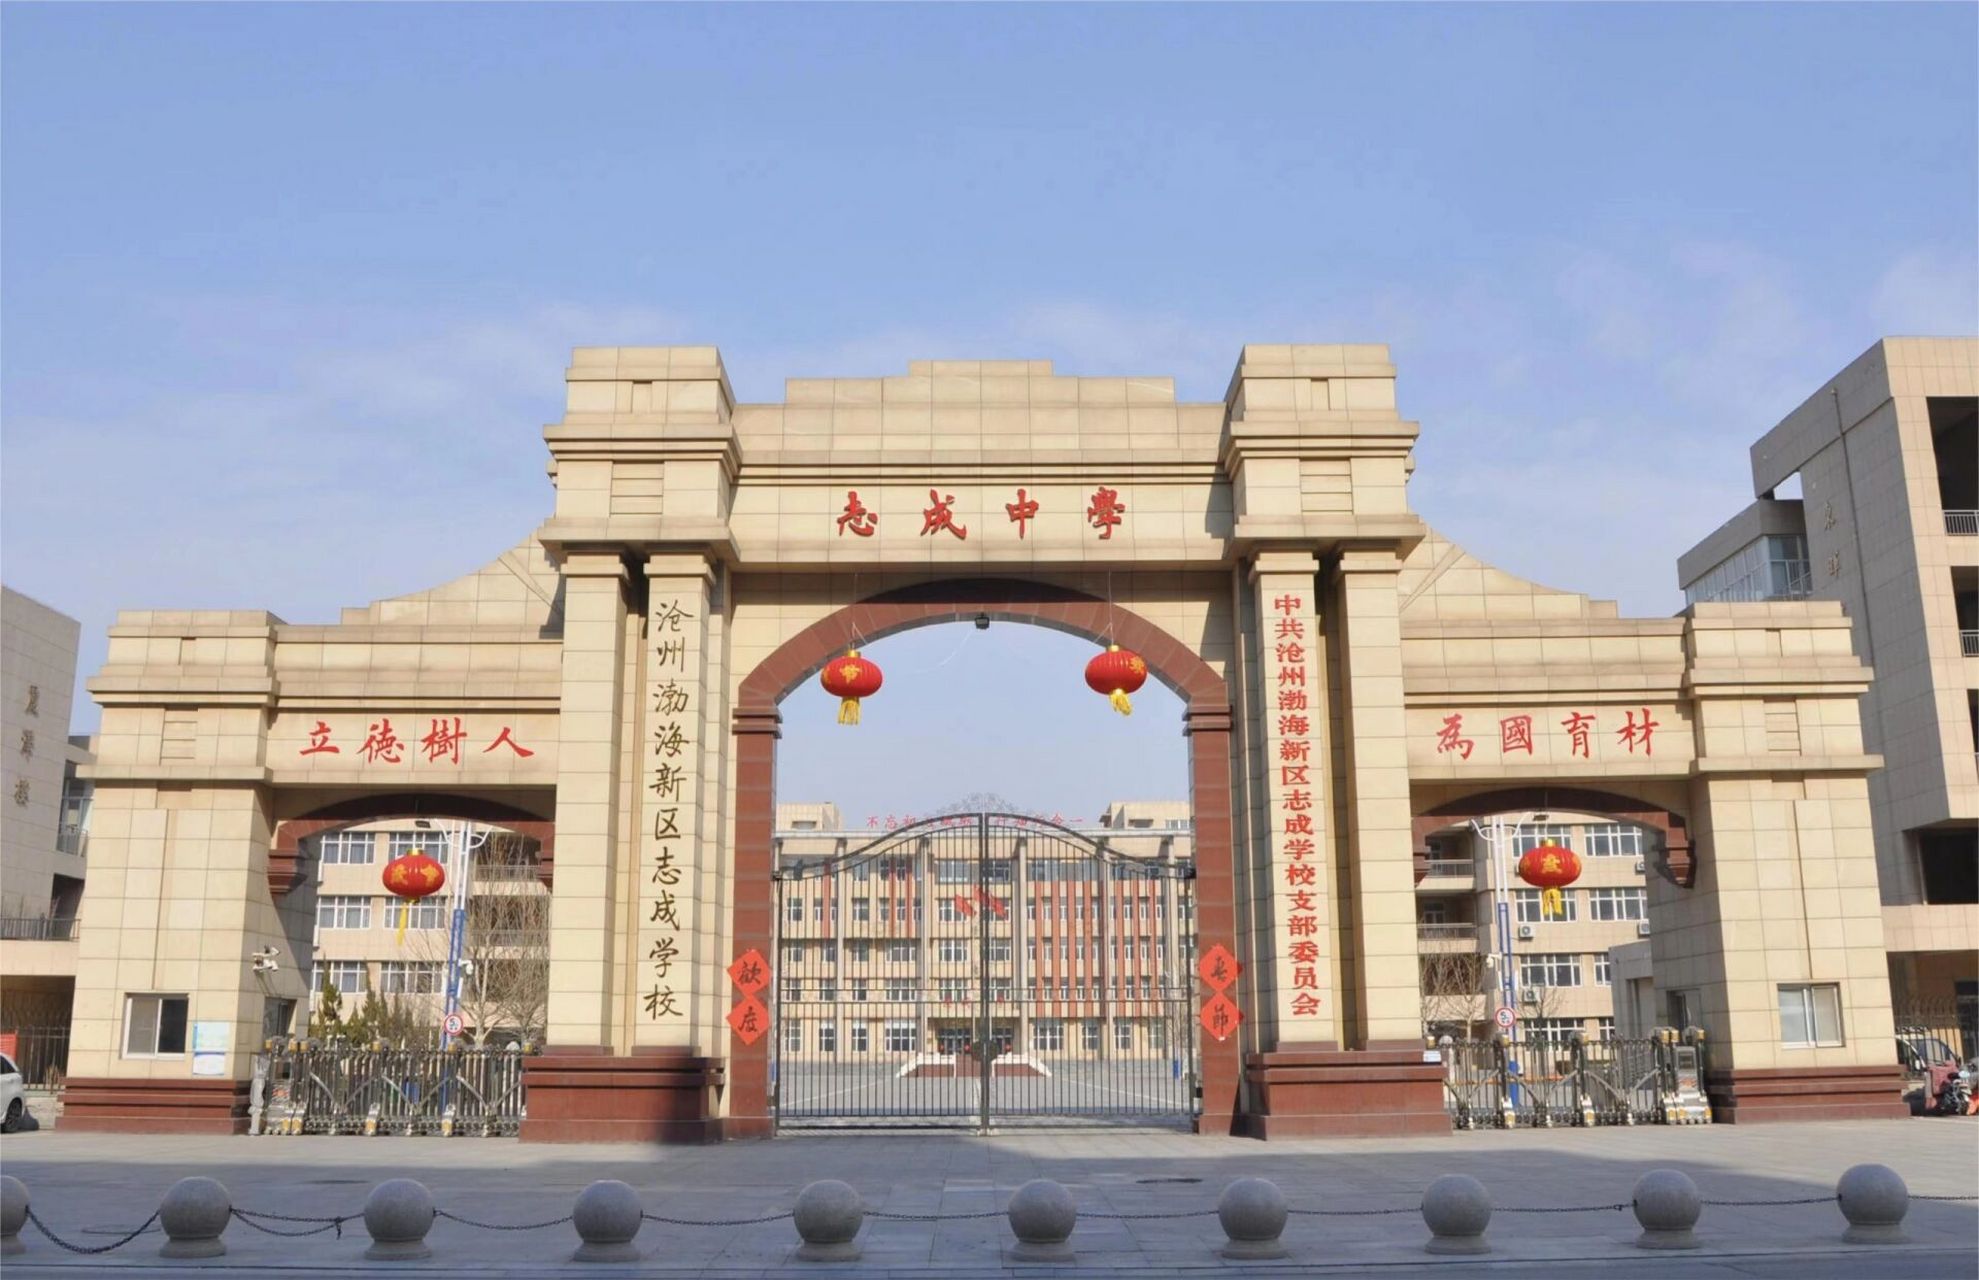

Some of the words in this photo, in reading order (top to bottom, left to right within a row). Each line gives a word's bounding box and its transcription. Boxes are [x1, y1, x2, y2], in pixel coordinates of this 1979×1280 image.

[837, 487, 1126, 539] 志成中學
[299, 716, 534, 765] 立德樹人
[643, 599, 694, 1020] 沧州渤海新区志成学校
[1274, 593, 1321, 1016] 中共沧州渤海新区志成学校支部委员会
